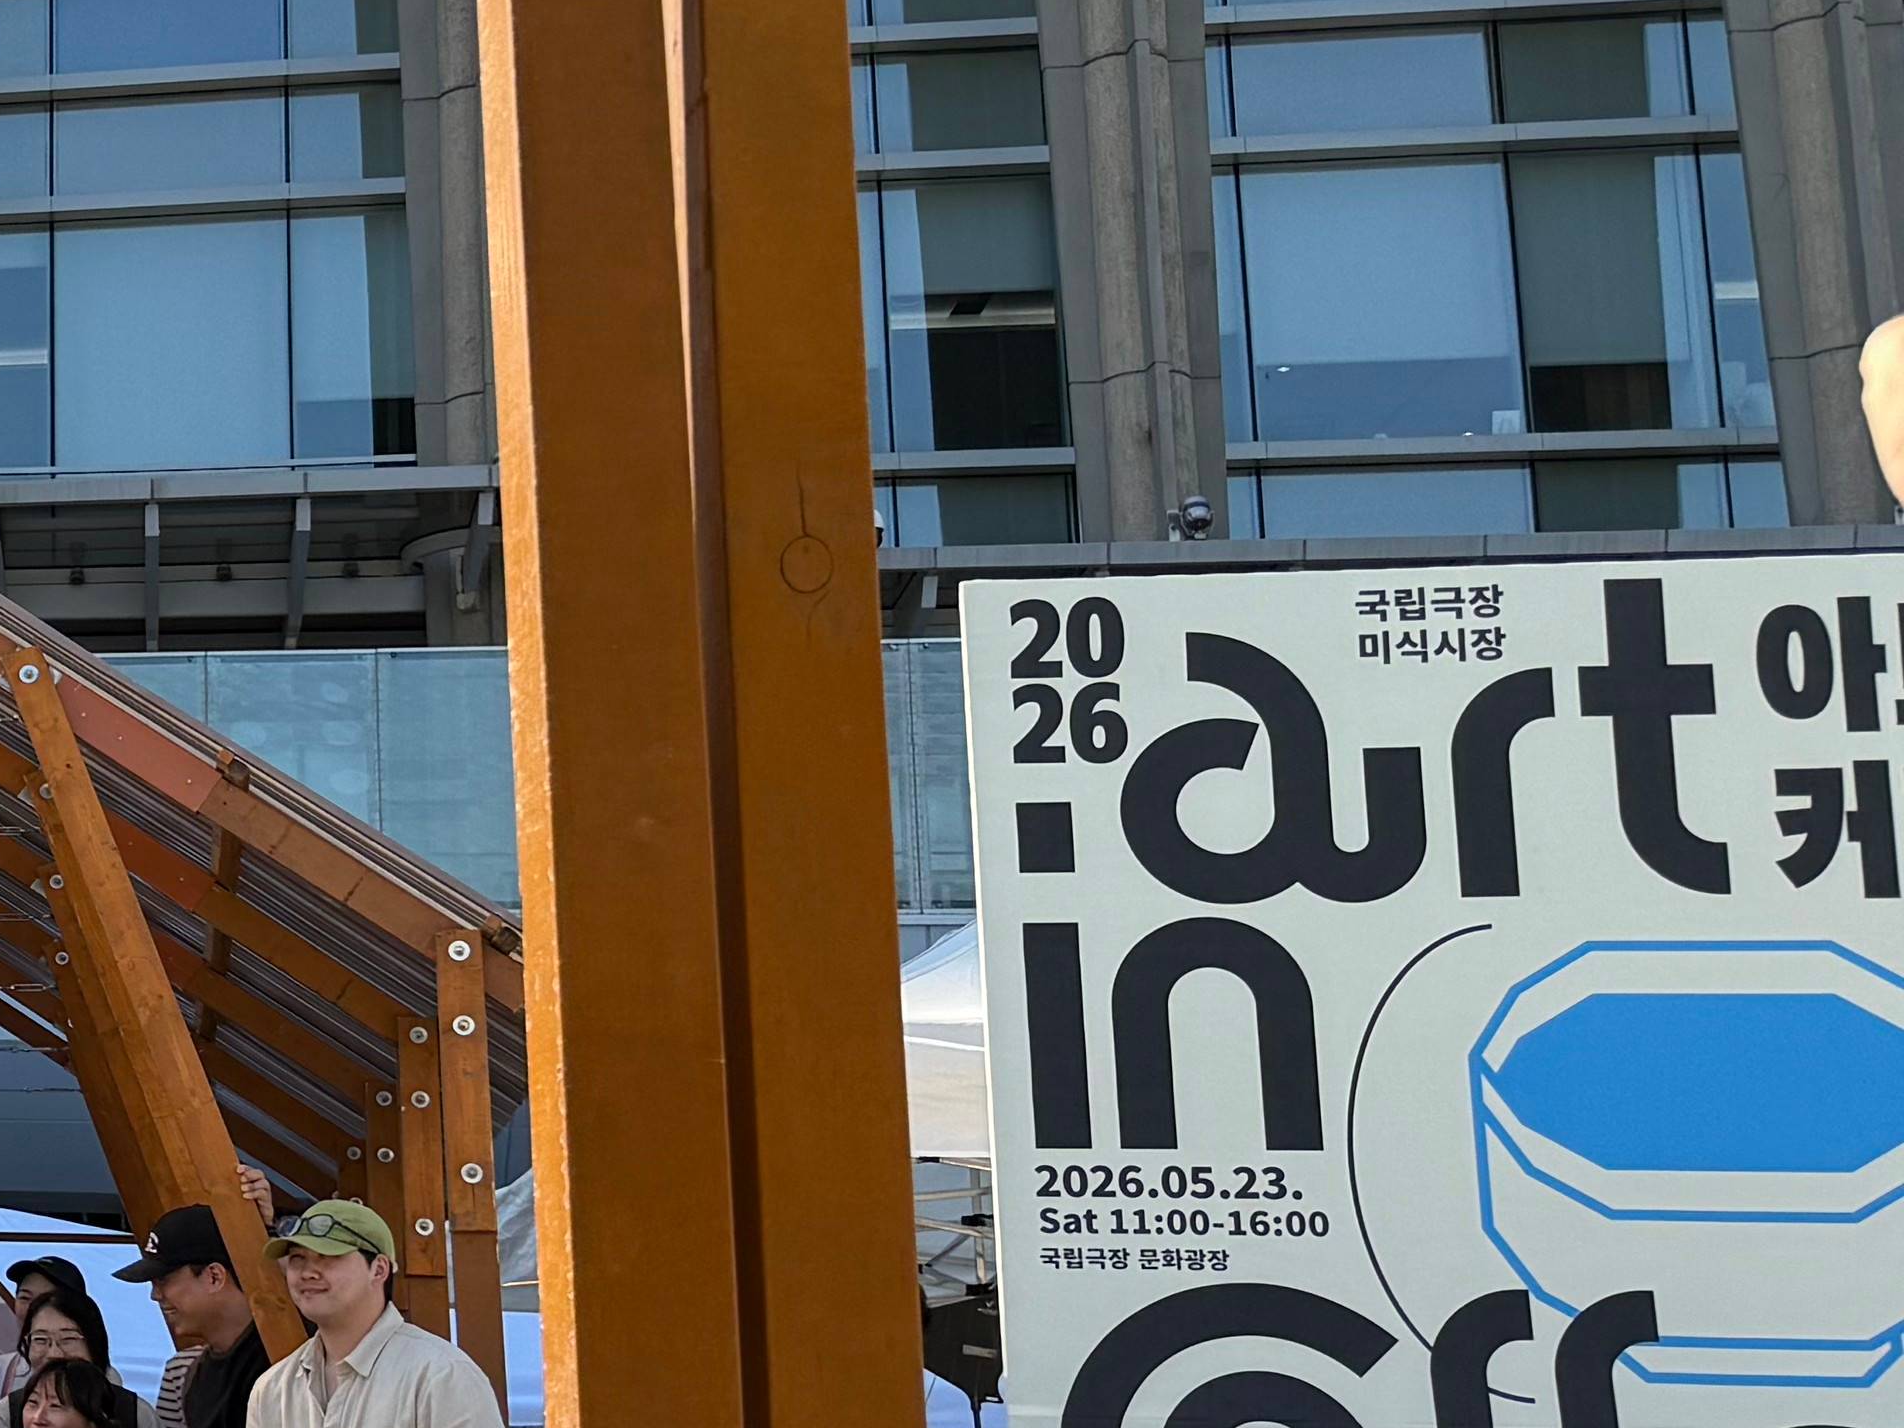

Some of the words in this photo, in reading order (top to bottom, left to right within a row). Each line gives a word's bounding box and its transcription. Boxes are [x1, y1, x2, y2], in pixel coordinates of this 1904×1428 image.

[1354, 585, 1503, 622] 국립극장
[1009, 597, 1125, 679] 20
[1357, 626, 1505, 665] 미식시장
[1756, 596, 1904, 732] 아
[1012, 682, 1128, 764] 26
[1015, 801, 1324, 1151] in
[1034, 1164, 1304, 1201] 2026.05.23.
[1039, 1208, 1098, 1236] Sat
[1108, 1208, 1330, 1239] 11:00-16:00
[1040, 1247, 1130, 1271] 국립극장
[1138, 1247, 1231, 1272] 문화광장
